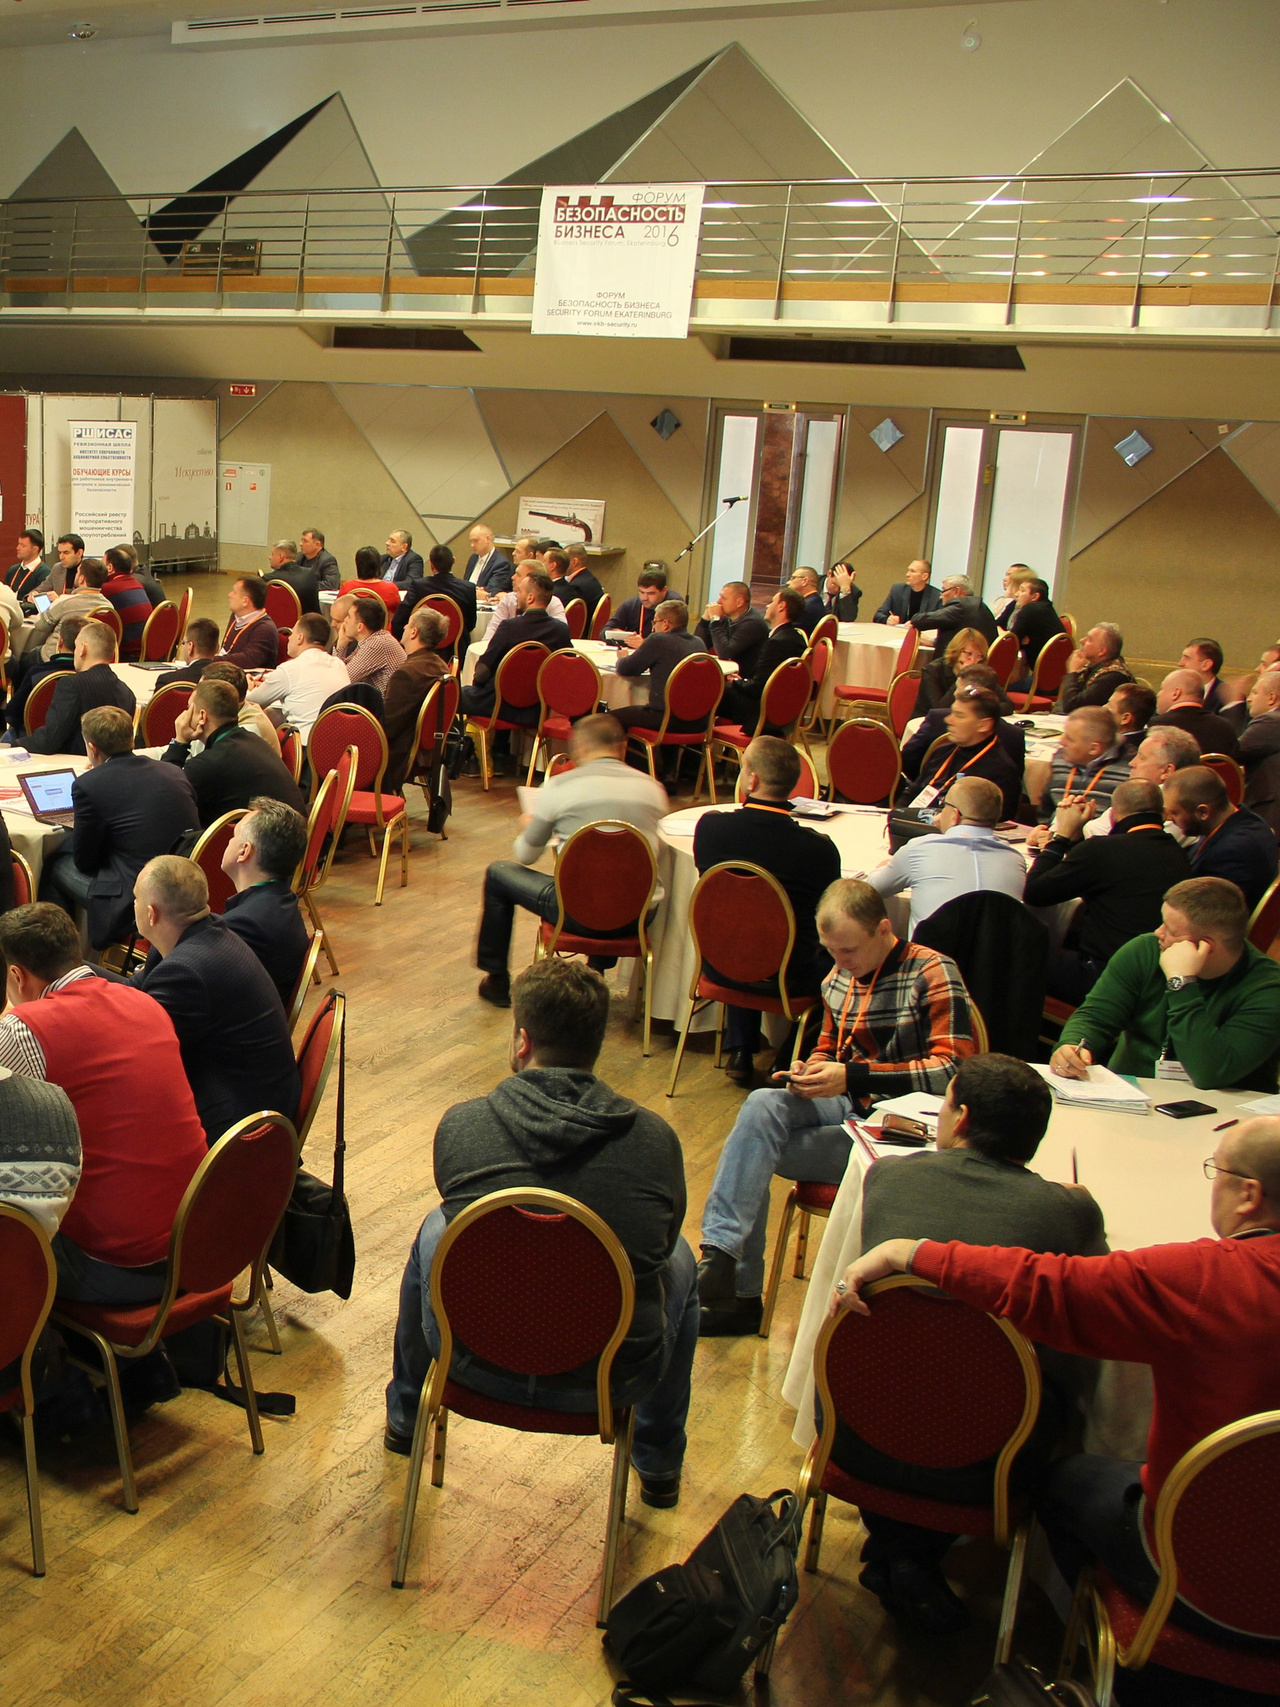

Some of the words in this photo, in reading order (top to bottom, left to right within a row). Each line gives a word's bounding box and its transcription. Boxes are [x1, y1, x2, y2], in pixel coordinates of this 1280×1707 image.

[631, 191, 687, 204] ФОРУМ
[556, 206, 684, 223] БЕЗОПАСНОСТЬ
[554, 225, 626, 239] БИЗНЕСА
[643, 225, 680, 248] 2016
[553, 239, 578, 247] Business
[579, 239, 604, 247] Security
[626, 240, 667, 248] Ekaterinburg
[595, 291, 626, 300] ФОРУМ
[558, 299, 623, 309] БЕЗОПАСНОСТЬ
[624, 301, 661, 310] БИЗНЕСА
[546, 308, 582, 317] SECURITY
[583, 309, 613, 318] FORUM
[614, 310, 673, 319] EKATERINBURG
[577, 320, 638, 329] www.ekb-security.ru
[74, 428, 94, 438] РШ
[96, 428, 132, 439] ИСАС
[72, 468, 111, 477] ОБУЧАЮЩИЕ
[112, 468, 131, 476] КУРСЫ
[24, 513, 41, 525] ТУРА
